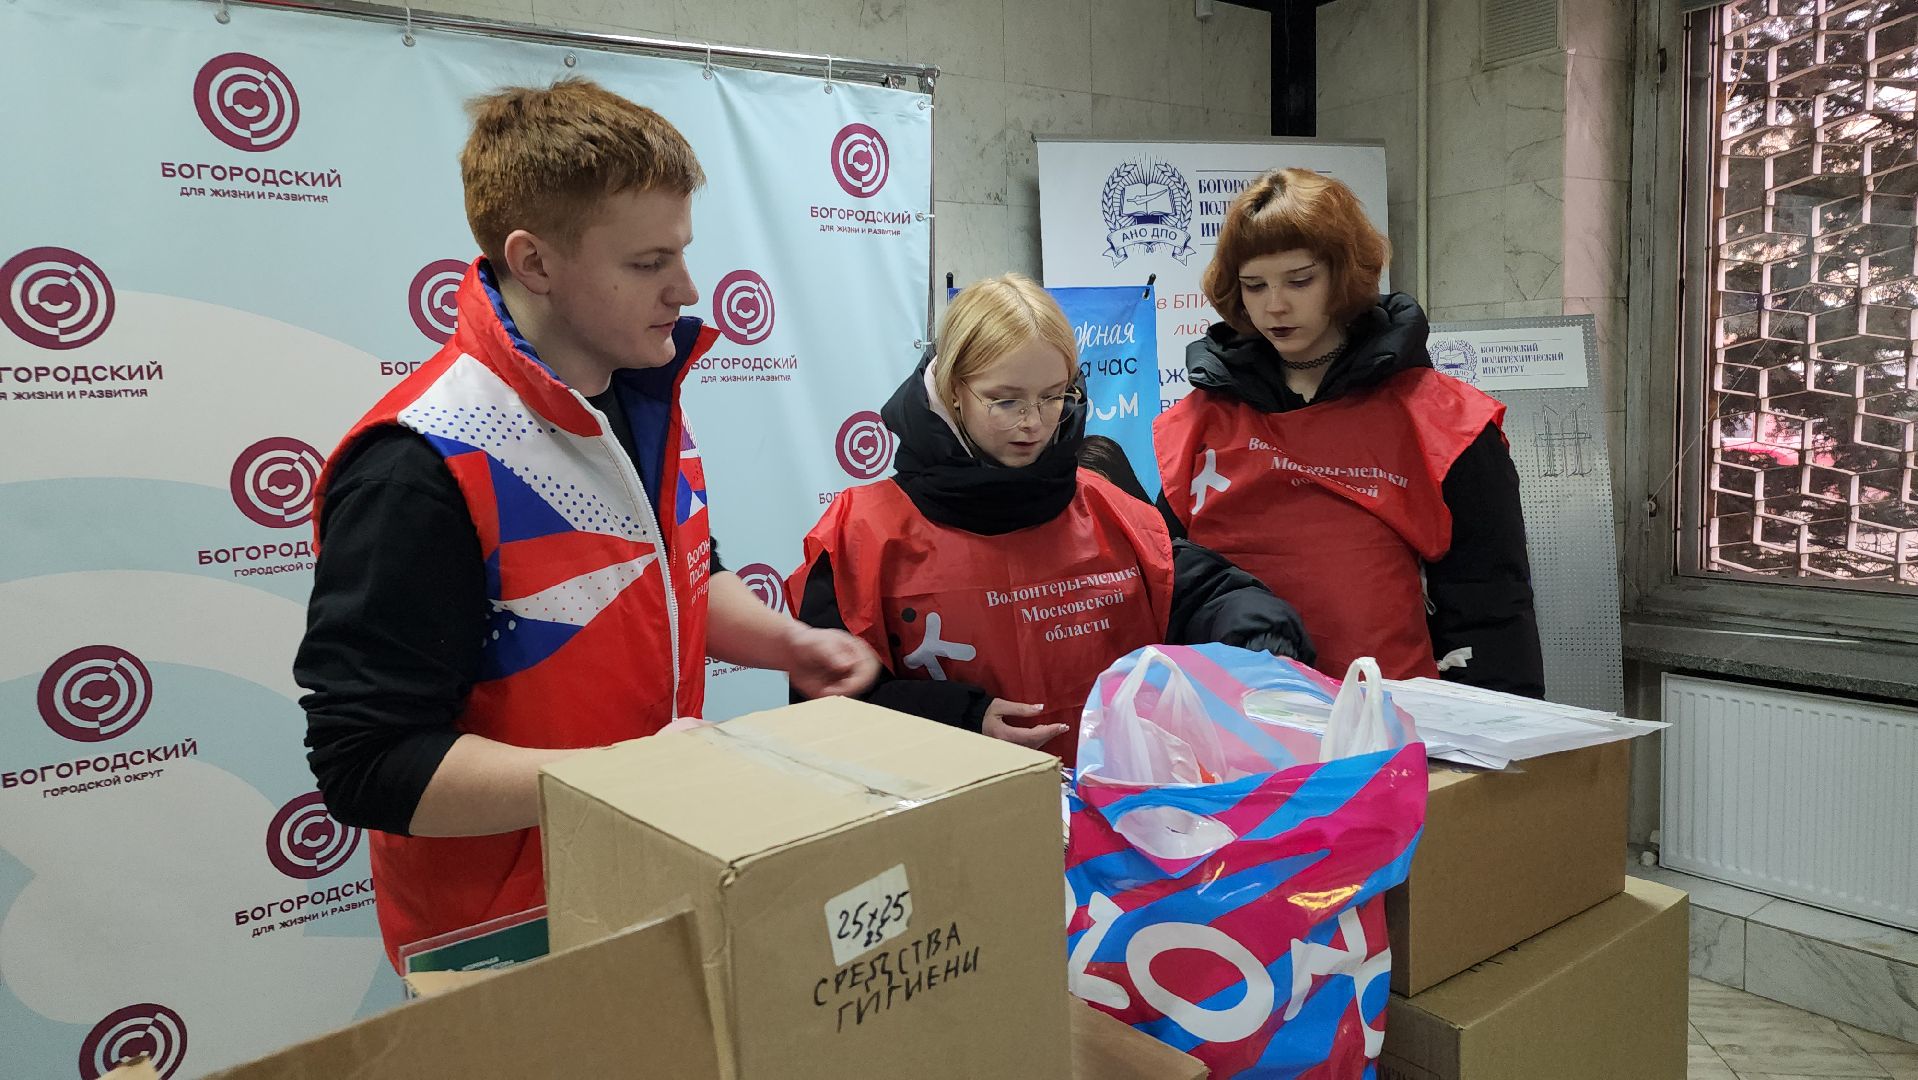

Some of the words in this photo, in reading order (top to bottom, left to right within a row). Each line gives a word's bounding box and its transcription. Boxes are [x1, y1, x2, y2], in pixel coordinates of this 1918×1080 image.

[160, 162, 342, 188] БОГОРОДСКИЙ
[180, 187, 206, 198] ДЛЯ
[210, 188, 255, 200] ЖИЗНИ
[257, 191, 266, 200] И
[268, 192, 329, 203] РАЗВИТИЯ
[1198, 178, 1250, 194] БОГОРО
[810, 206, 911, 225] БОГОРОДСКИЙ
[837, 225, 860, 234] ЖИЗНИ
[868, 228, 901, 236] РАЗВИТИЯ
[1122, 228, 1148, 243] АНО
[1151, 228, 1178, 240] ДПО
[1074, 321, 1136, 354] жная
[1480, 343, 1539, 354] БОГОРОДСКИЙ
[1481, 352, 1564, 364] ПОЛИТЕХНИЧЕСКИЙ
[0, 361, 164, 385] ГОРОДСКИЙ
[1097, 357, 1138, 376] час
[1482, 365, 1525, 375] ИНСТИТУТ
[701, 375, 717, 384] ДЛЯ
[719, 375, 747, 383] ЖИЗНИ
[12, 390, 64, 400] ЖИЗНИ
[67, 390, 76, 399] И
[80, 389, 149, 399] РАЗВИТИЯ
[198, 541, 311, 565] БОГОРОД
[234, 562, 304, 577] ГОРОДСКОЙ
[1021, 589, 1124, 624] Московской
[1045, 617, 1110, 642] области
[1, 737, 198, 789] БОГОРОДСКИЙ
[43, 775, 122, 798] ГОРОДСКОЙ
[124, 769, 164, 783] ОКРУГ
[235, 878, 374, 926] БОГОРОДСК
[252, 924, 275, 938] ДЛЯ
[279, 912, 319, 930] ЖИЗНИ
[321, 910, 329, 918] И
[331, 898, 376, 915] РАЗВИТ
[813, 921, 961, 1007] СРЕДСТВА
